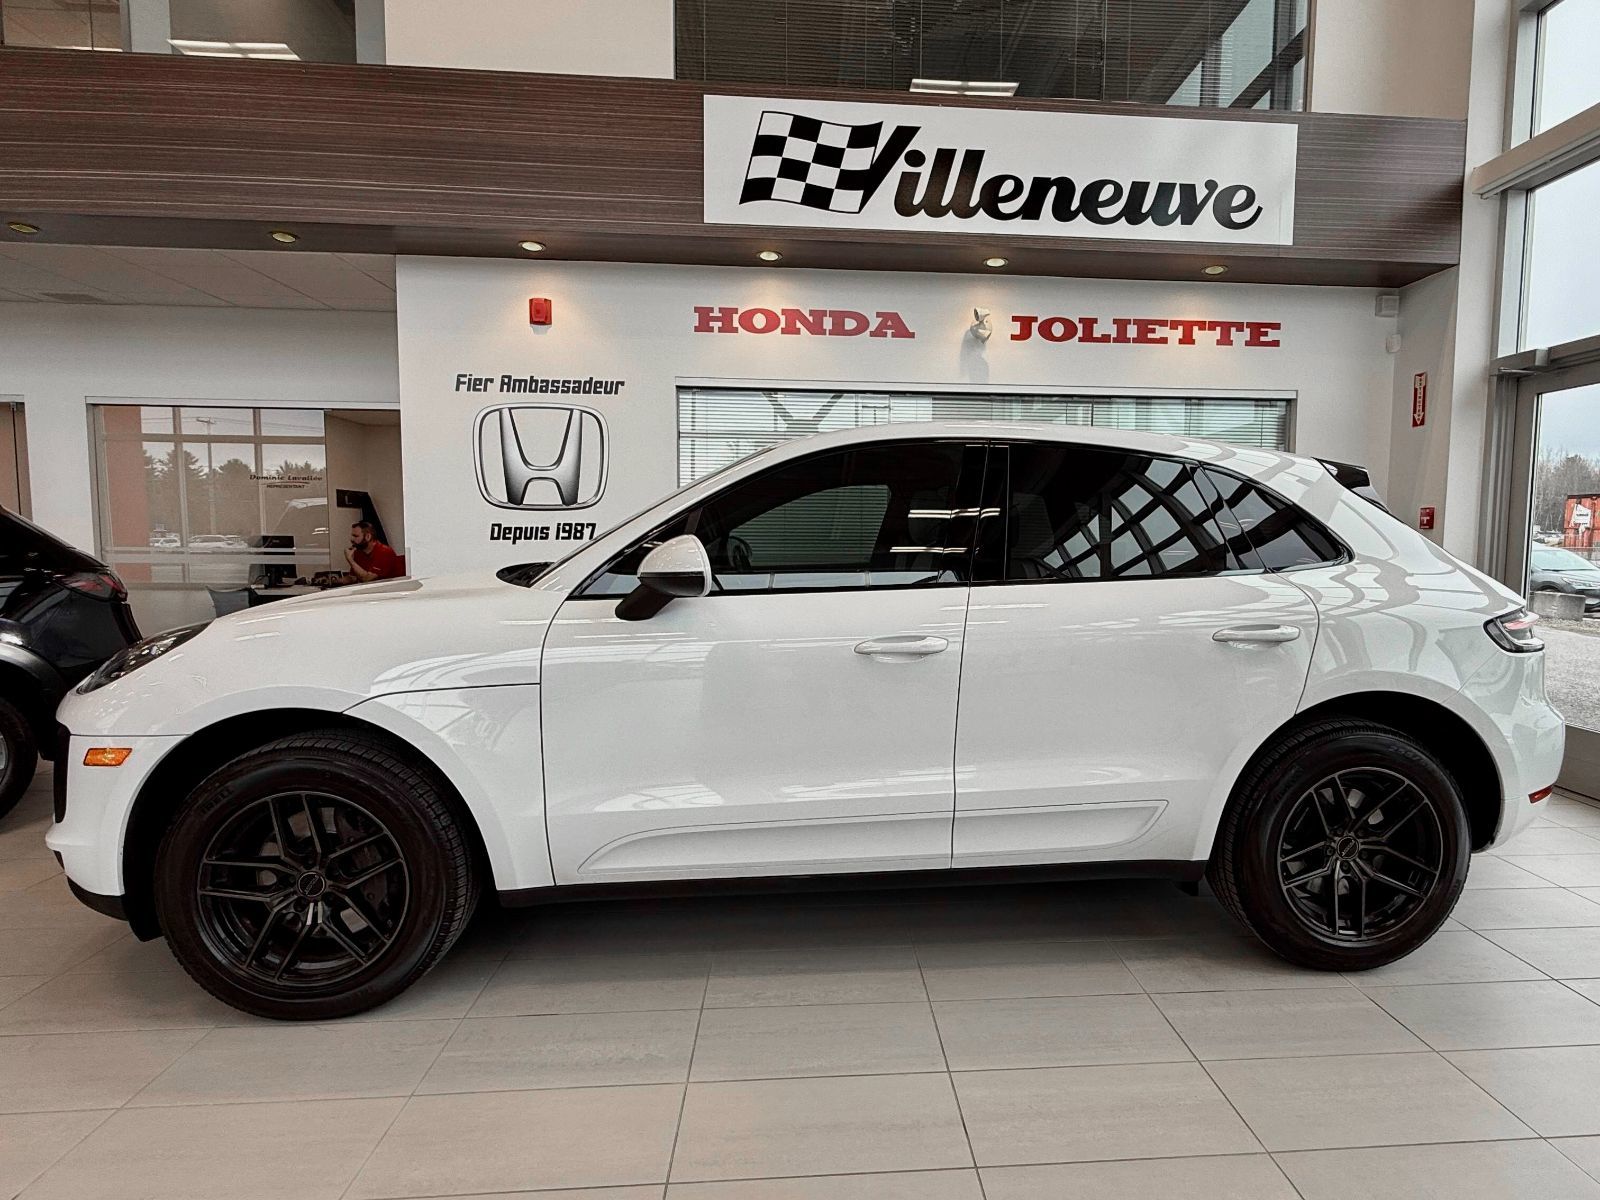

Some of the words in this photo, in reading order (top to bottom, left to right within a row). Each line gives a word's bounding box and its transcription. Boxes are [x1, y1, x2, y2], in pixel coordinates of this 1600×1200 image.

[857, 123, 1264, 231] Villeneuve
[693, 305, 916, 339] HONDA
[1010, 315, 1282, 348] JOLIETTE
[455, 373, 494, 392] Fier
[499, 374, 625, 395] Ambassadeur
[490, 522, 550, 545] Depuis
[555, 522, 597, 541] 1987
